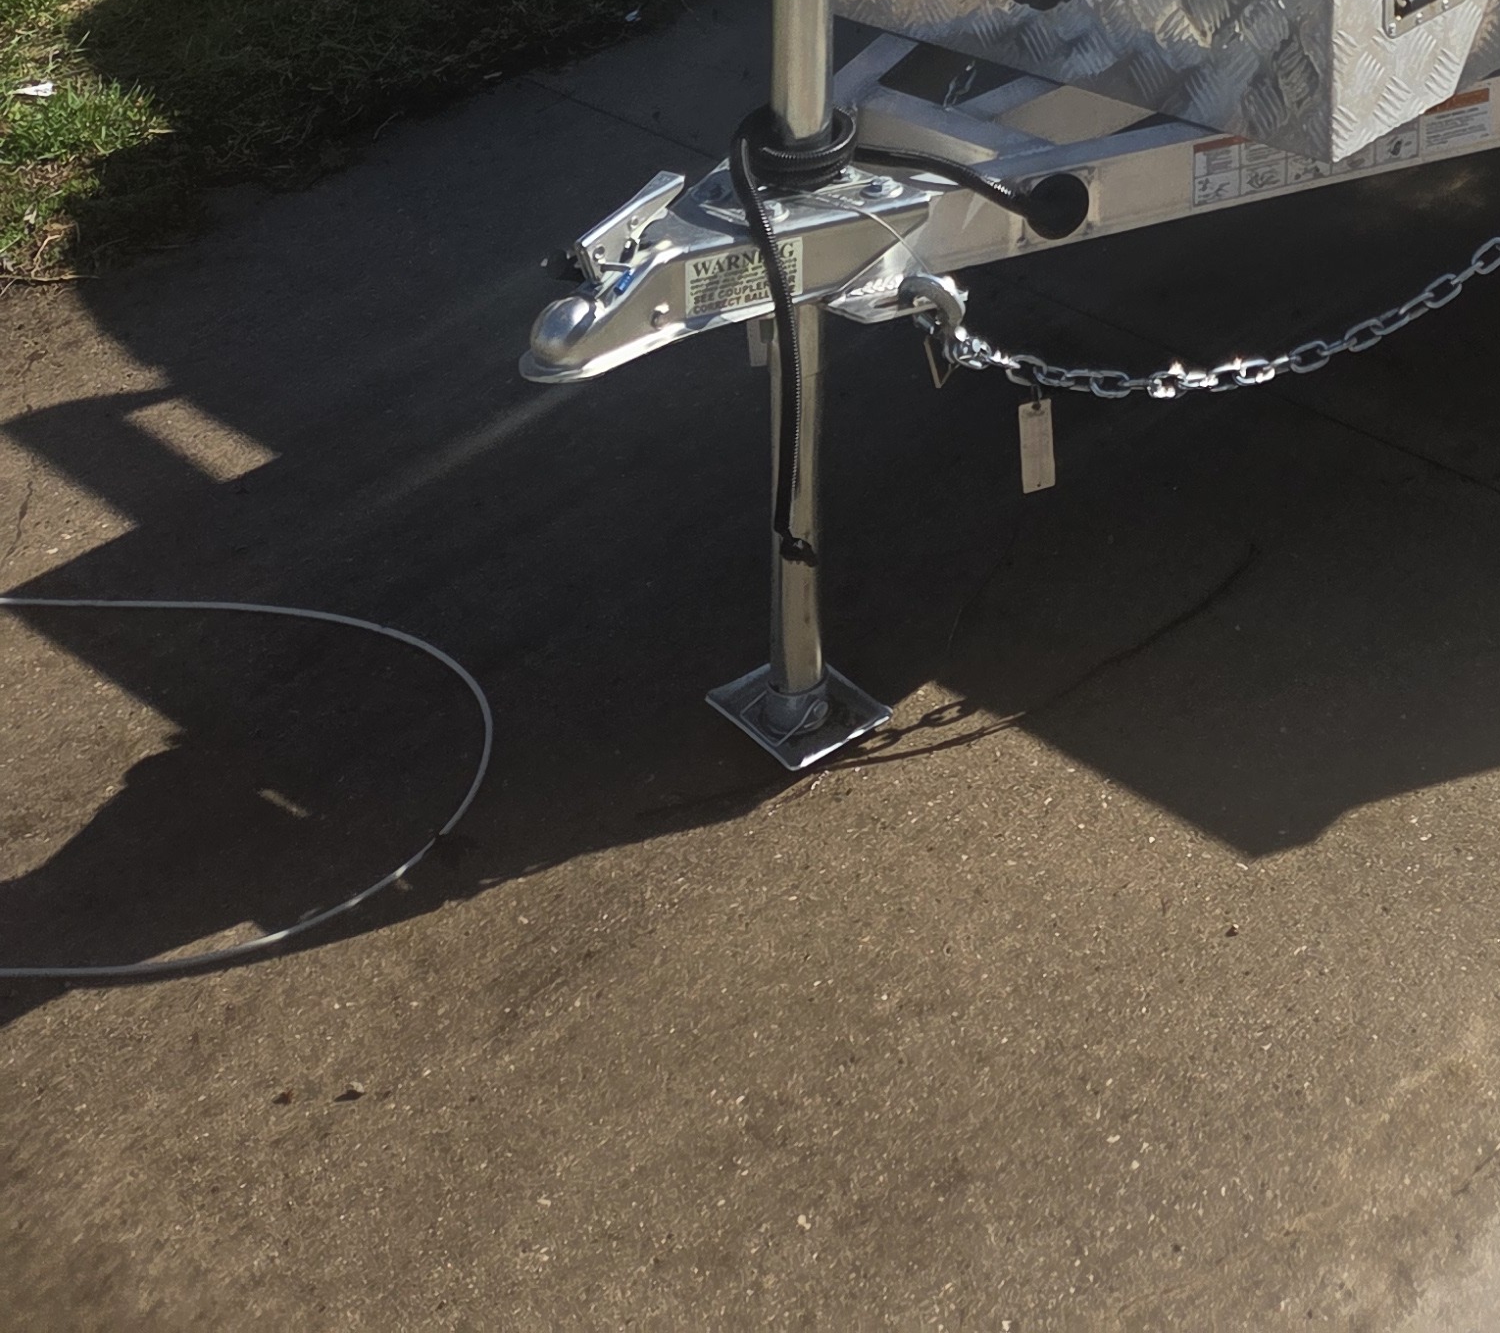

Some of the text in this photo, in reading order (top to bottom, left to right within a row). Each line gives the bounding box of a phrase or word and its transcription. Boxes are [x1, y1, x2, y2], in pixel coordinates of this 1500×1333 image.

[693, 242, 794, 277] WARNG
[693, 292, 714, 305] SEE
[693, 297, 742, 314] CORRECT
